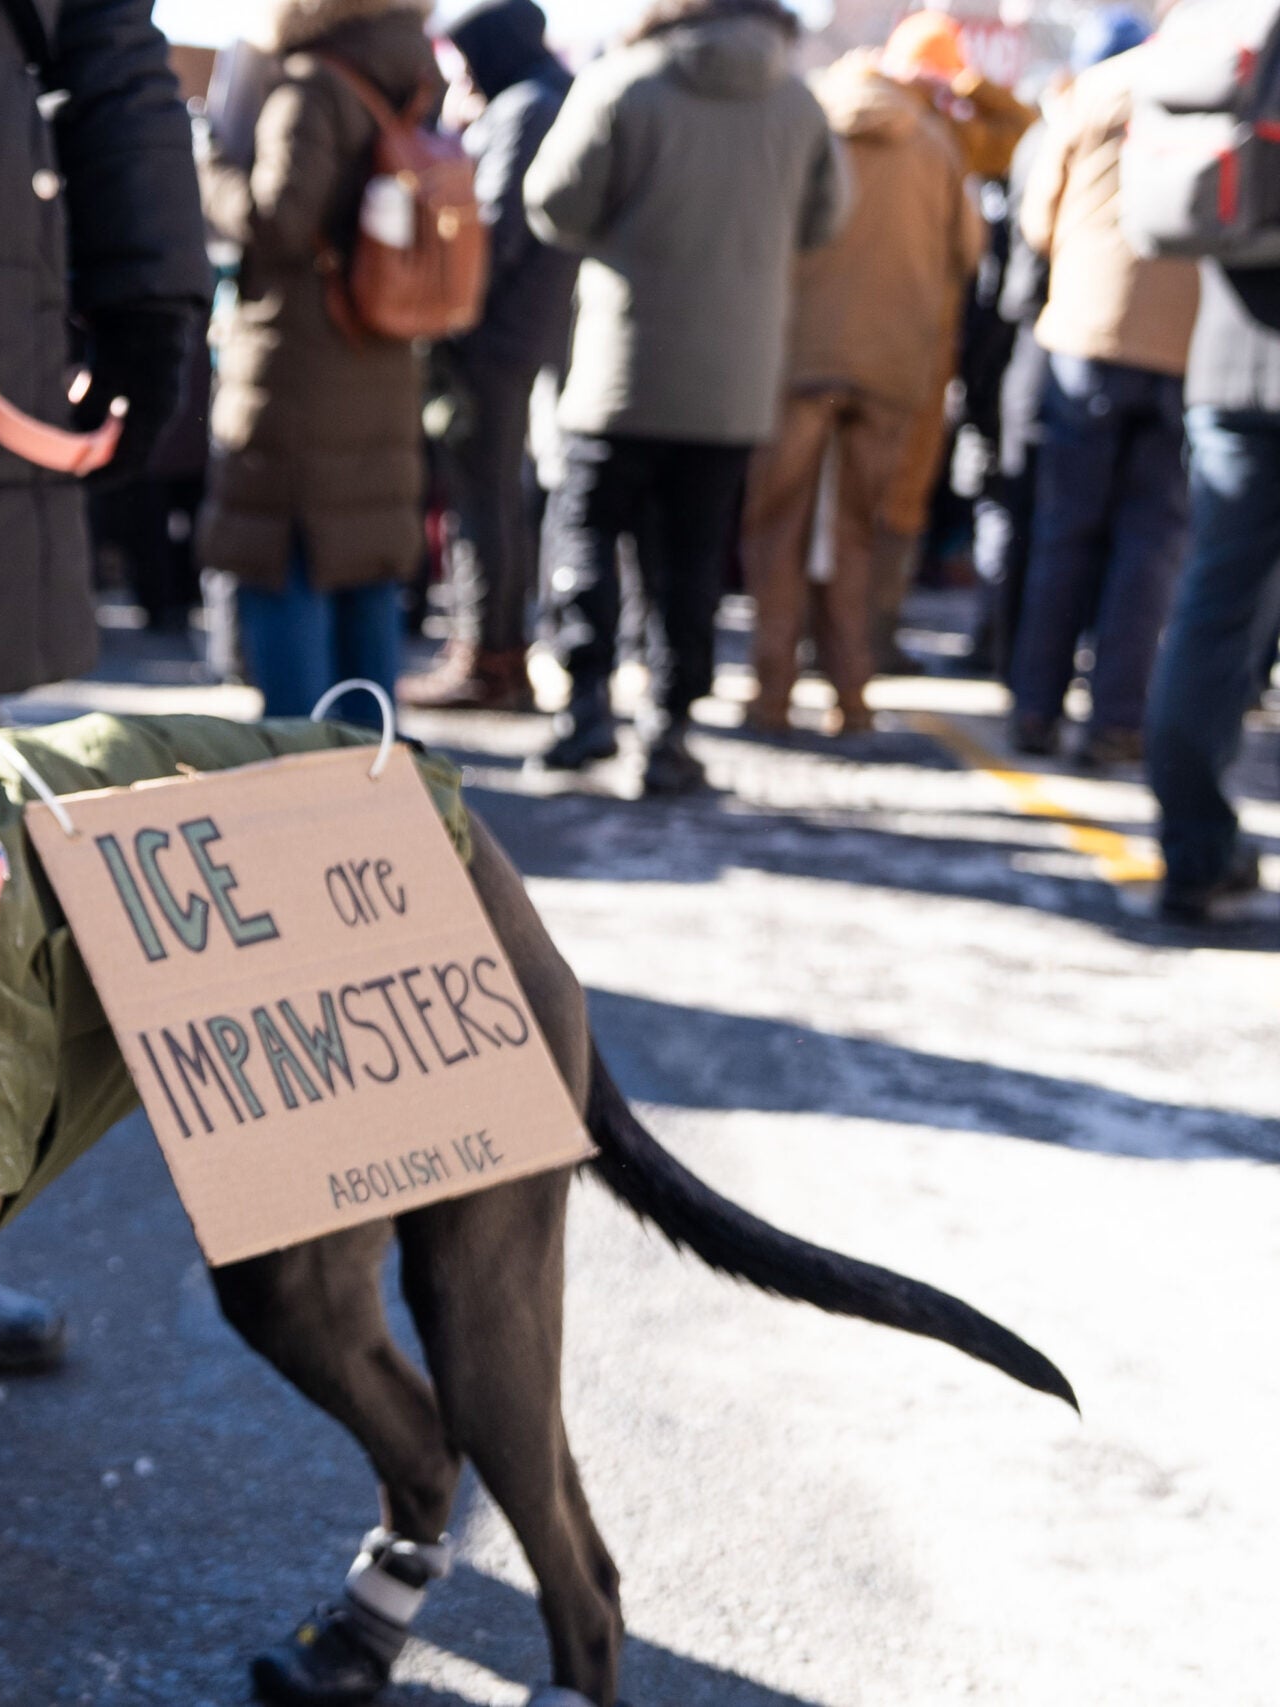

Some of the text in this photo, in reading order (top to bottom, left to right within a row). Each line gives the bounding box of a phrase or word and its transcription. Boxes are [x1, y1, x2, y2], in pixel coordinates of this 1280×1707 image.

[95, 817, 407, 963] ICE are
[138, 956, 529, 1139] IMPAWSTERS
[328, 1129, 504, 1209] ABOLISH ICE
